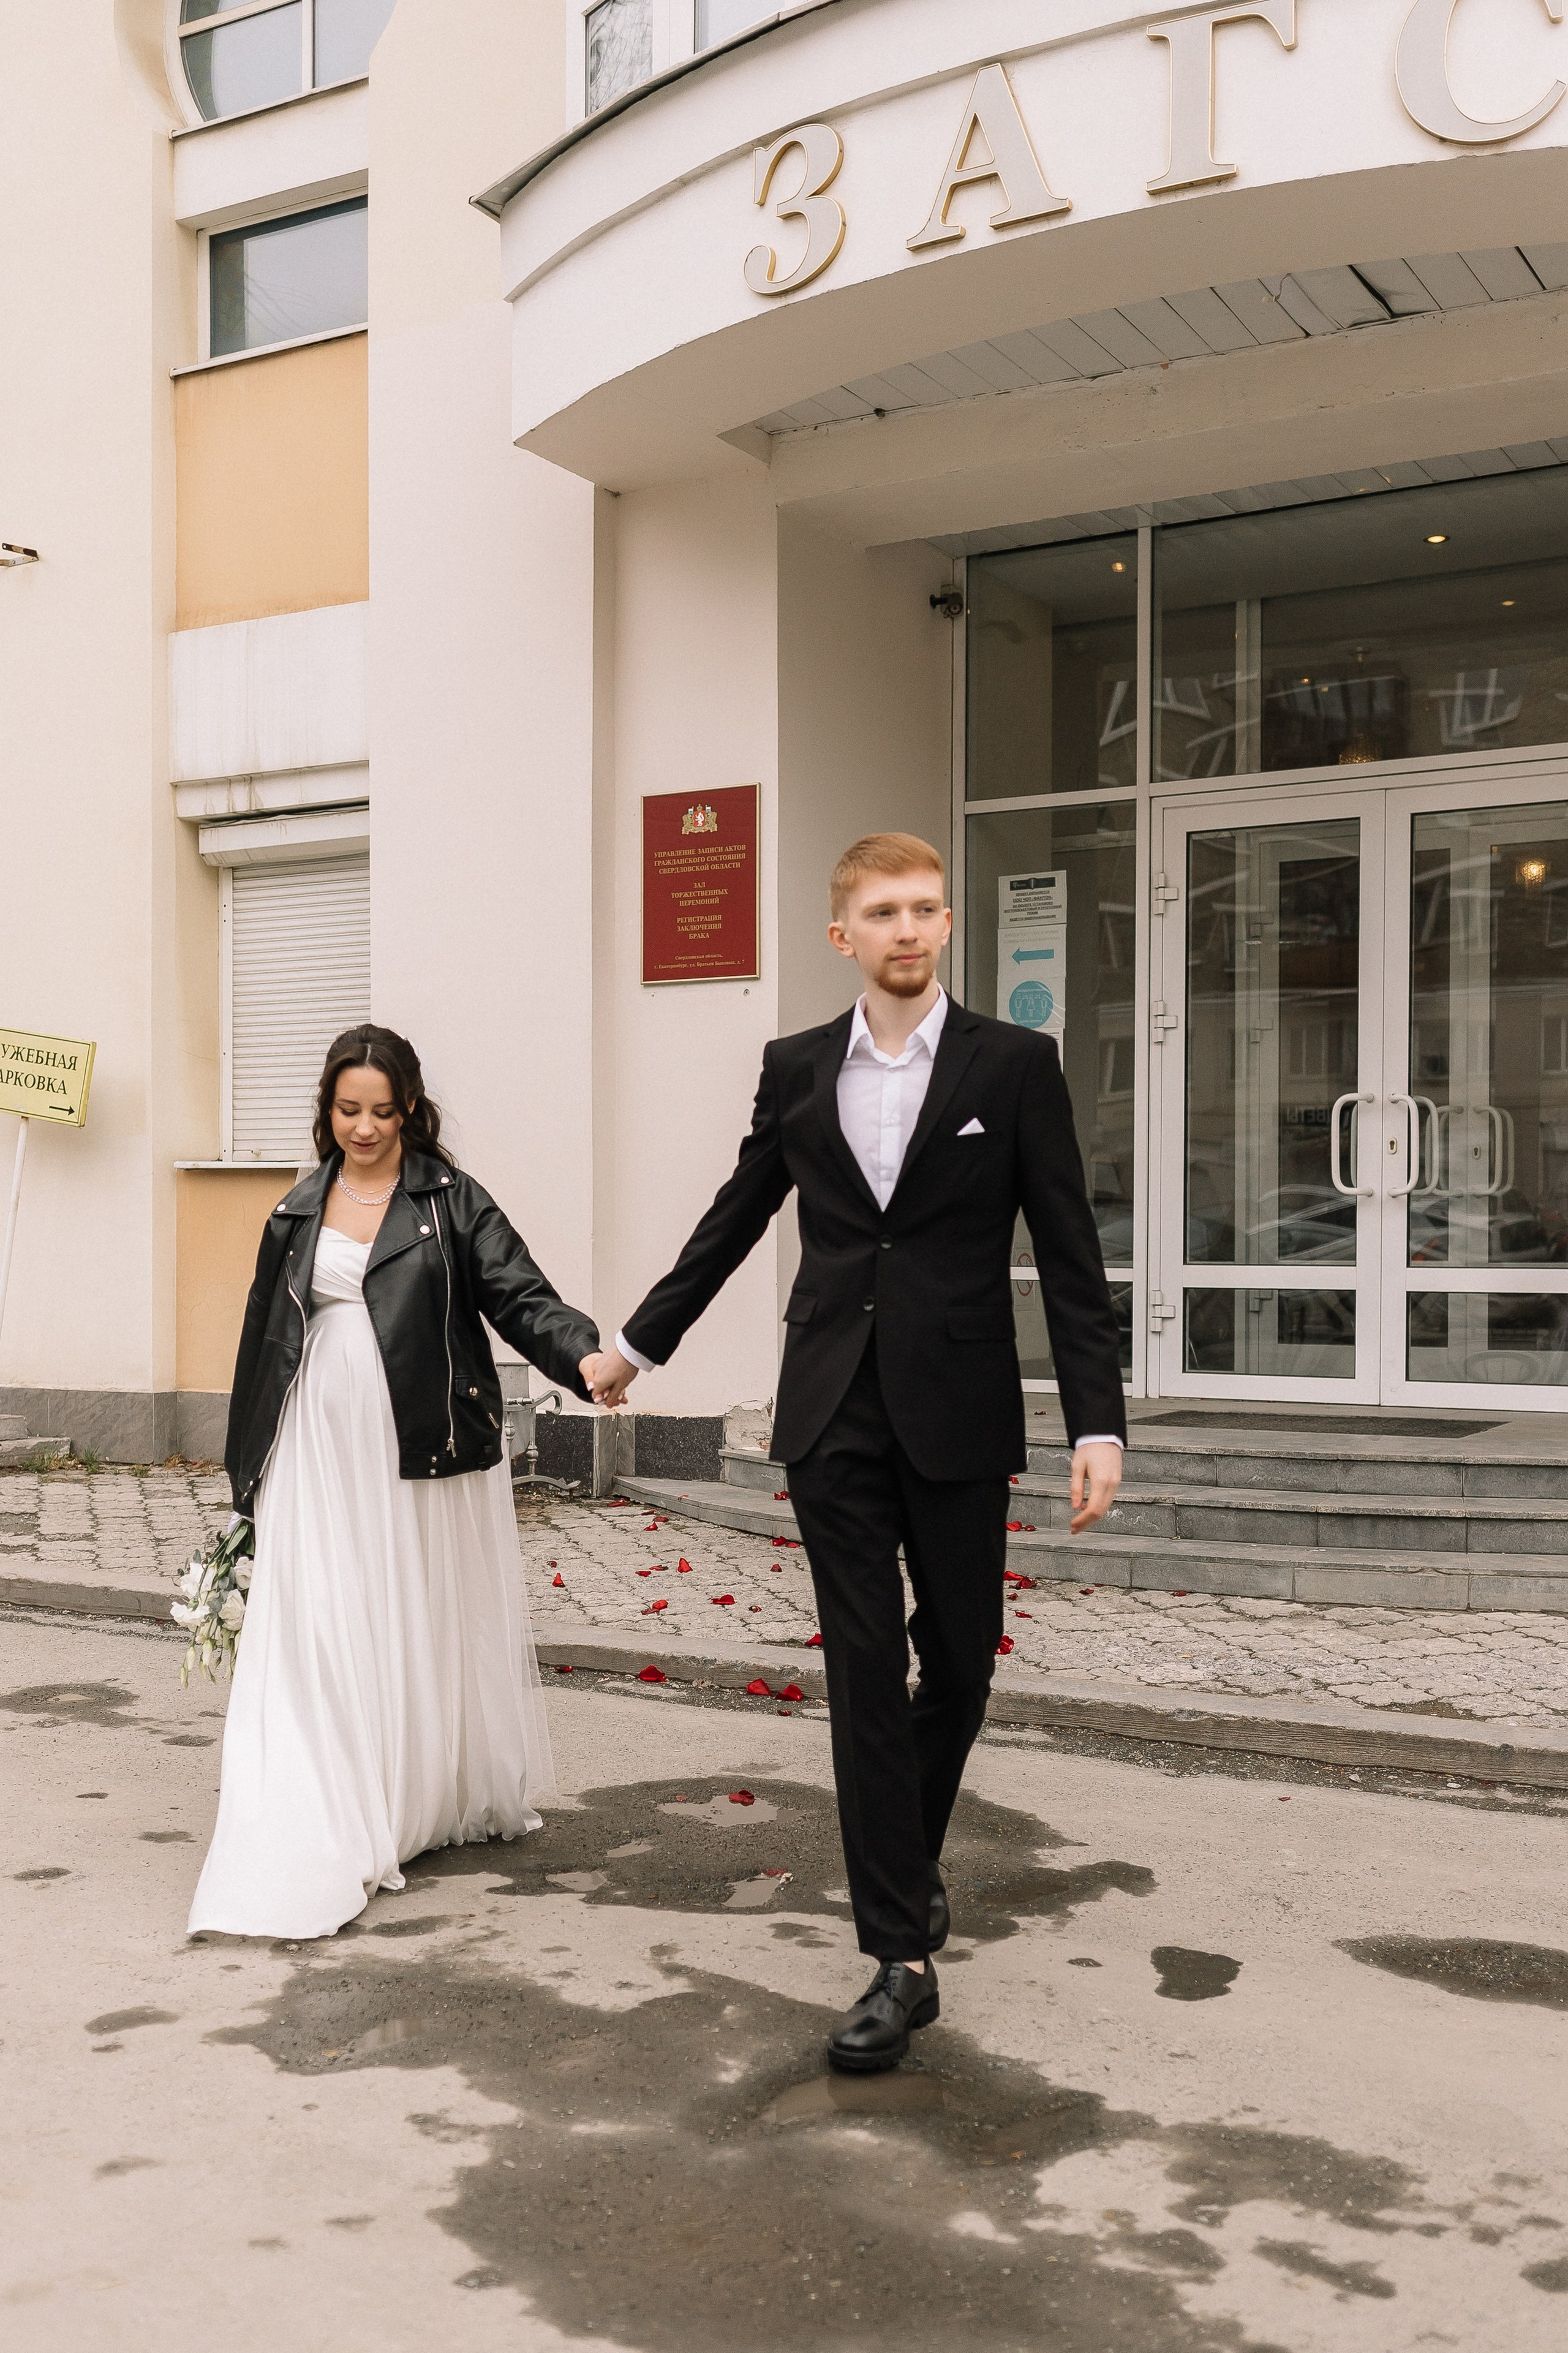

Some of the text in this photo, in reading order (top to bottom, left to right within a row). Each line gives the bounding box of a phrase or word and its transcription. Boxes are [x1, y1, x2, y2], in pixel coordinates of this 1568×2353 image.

[743, 0, 1567, 296] ЗАГС
[654, 849, 696, 858] УПРАВЛЕНИЕ
[654, 853, 746, 866] ГРАЖДАНСКОГО СОСТОЯНИЯ
[658, 864, 709, 874] СВЕРДЛОВСКОЙ
[671, 888, 728, 898] ТОРЖЕСТВЕННЫХ
[679, 896, 720, 907] ЦЕРЕМОНИЙ
[676, 914, 722, 923] РЕГИСТРАЦИЯ
[676, 923, 722, 932] ЗАКЛЮЧЕНИЯ
